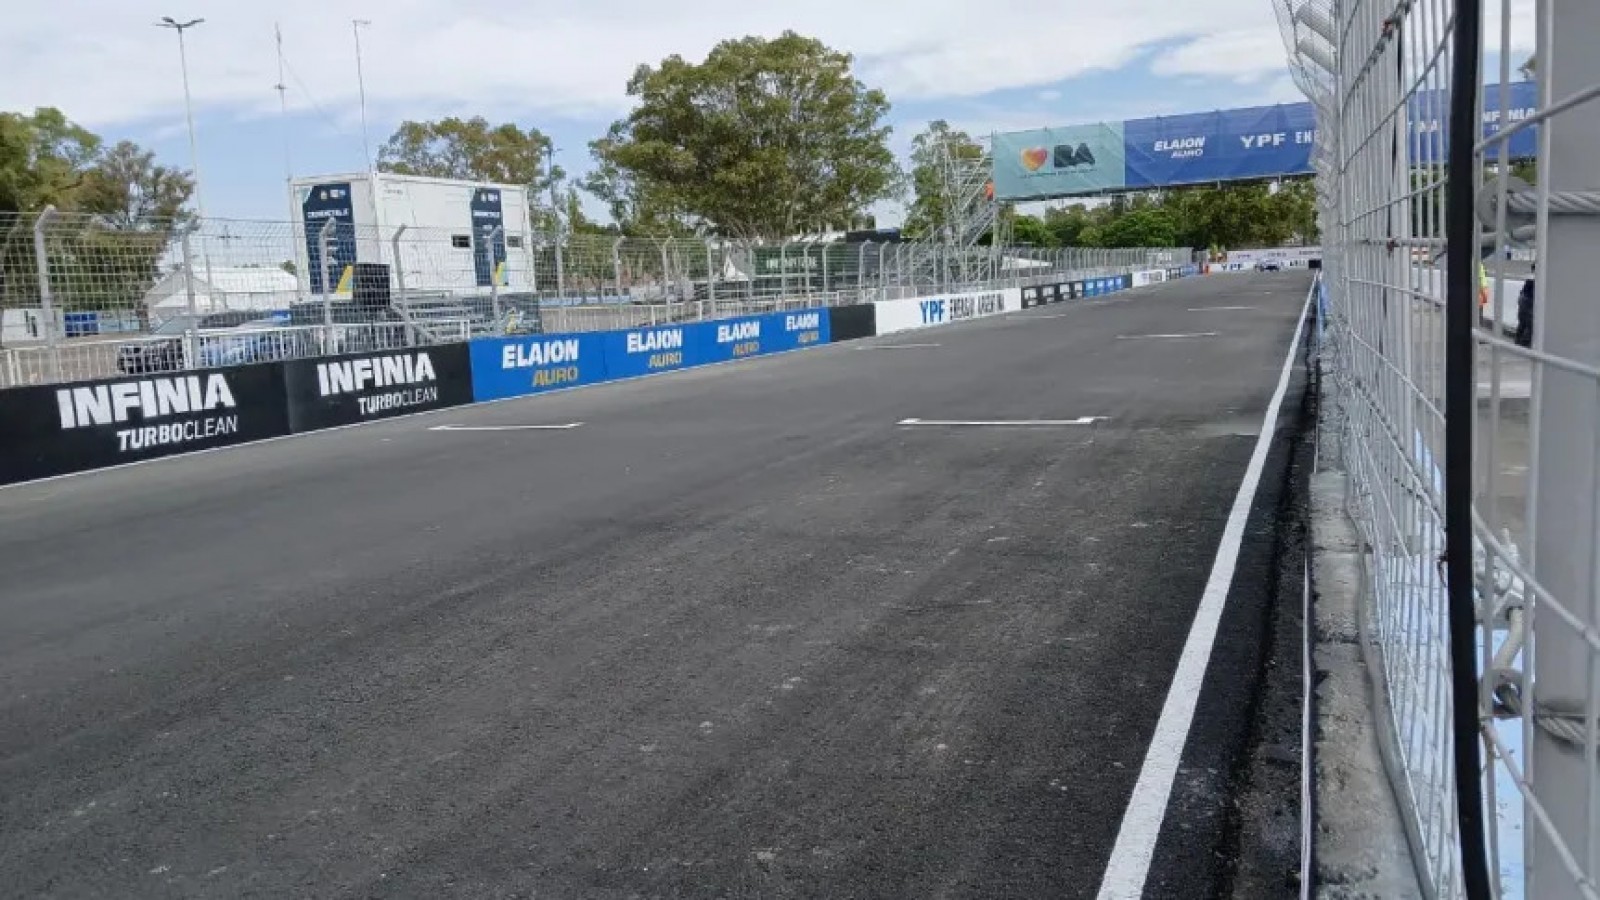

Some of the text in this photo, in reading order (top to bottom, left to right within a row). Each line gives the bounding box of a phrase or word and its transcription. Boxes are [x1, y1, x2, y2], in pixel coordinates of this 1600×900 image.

[1482, 107, 1536, 122] NFNIA
[1153, 135, 1206, 152] ELAION
[1240, 132, 1287, 148] YPF
[1053, 142, 1096, 168] BA
[785, 312, 821, 333] ELAION
[920, 298, 946, 324] YPF
[626, 328, 684, 355] ELAION
[716, 321, 761, 344] ELAION
[797, 329, 820, 344] AURO
[501, 338, 580, 370] ELAION
[648, 350, 684, 369] AURO
[732, 341, 761, 357] AURO
[317, 351, 437, 397] INFINIA
[531, 365, 579, 389] AURO
[56, 373, 237, 430] INFINIA
[357, 386, 438, 416] TURBOCLEAN
[116, 415, 239, 453] TURBOCLEAN
